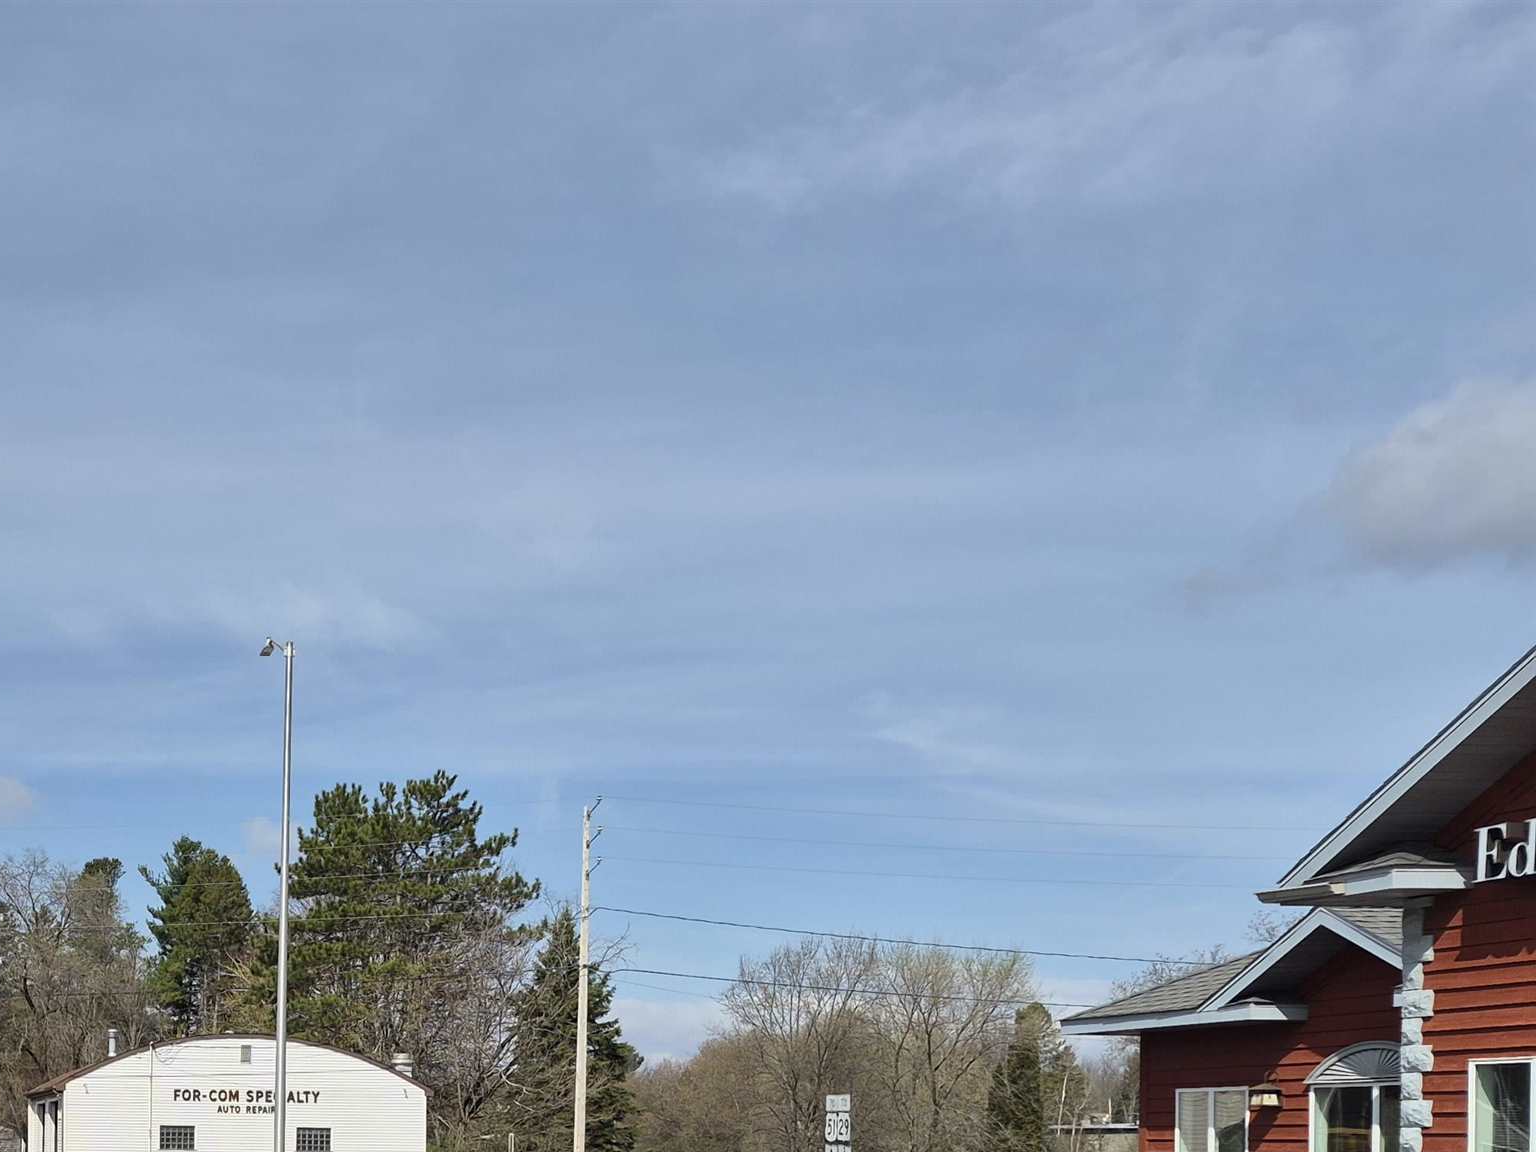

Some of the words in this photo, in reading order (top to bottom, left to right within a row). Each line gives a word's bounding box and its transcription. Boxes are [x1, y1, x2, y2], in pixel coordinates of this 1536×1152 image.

[173, 1089, 240, 1103] FOR-COM
[246, 1090, 320, 1104] SPEALTY
[217, 1105, 241, 1114] AUTO
[827, 1118, 837, 1137] 51
[839, 1118, 849, 1137] 29
